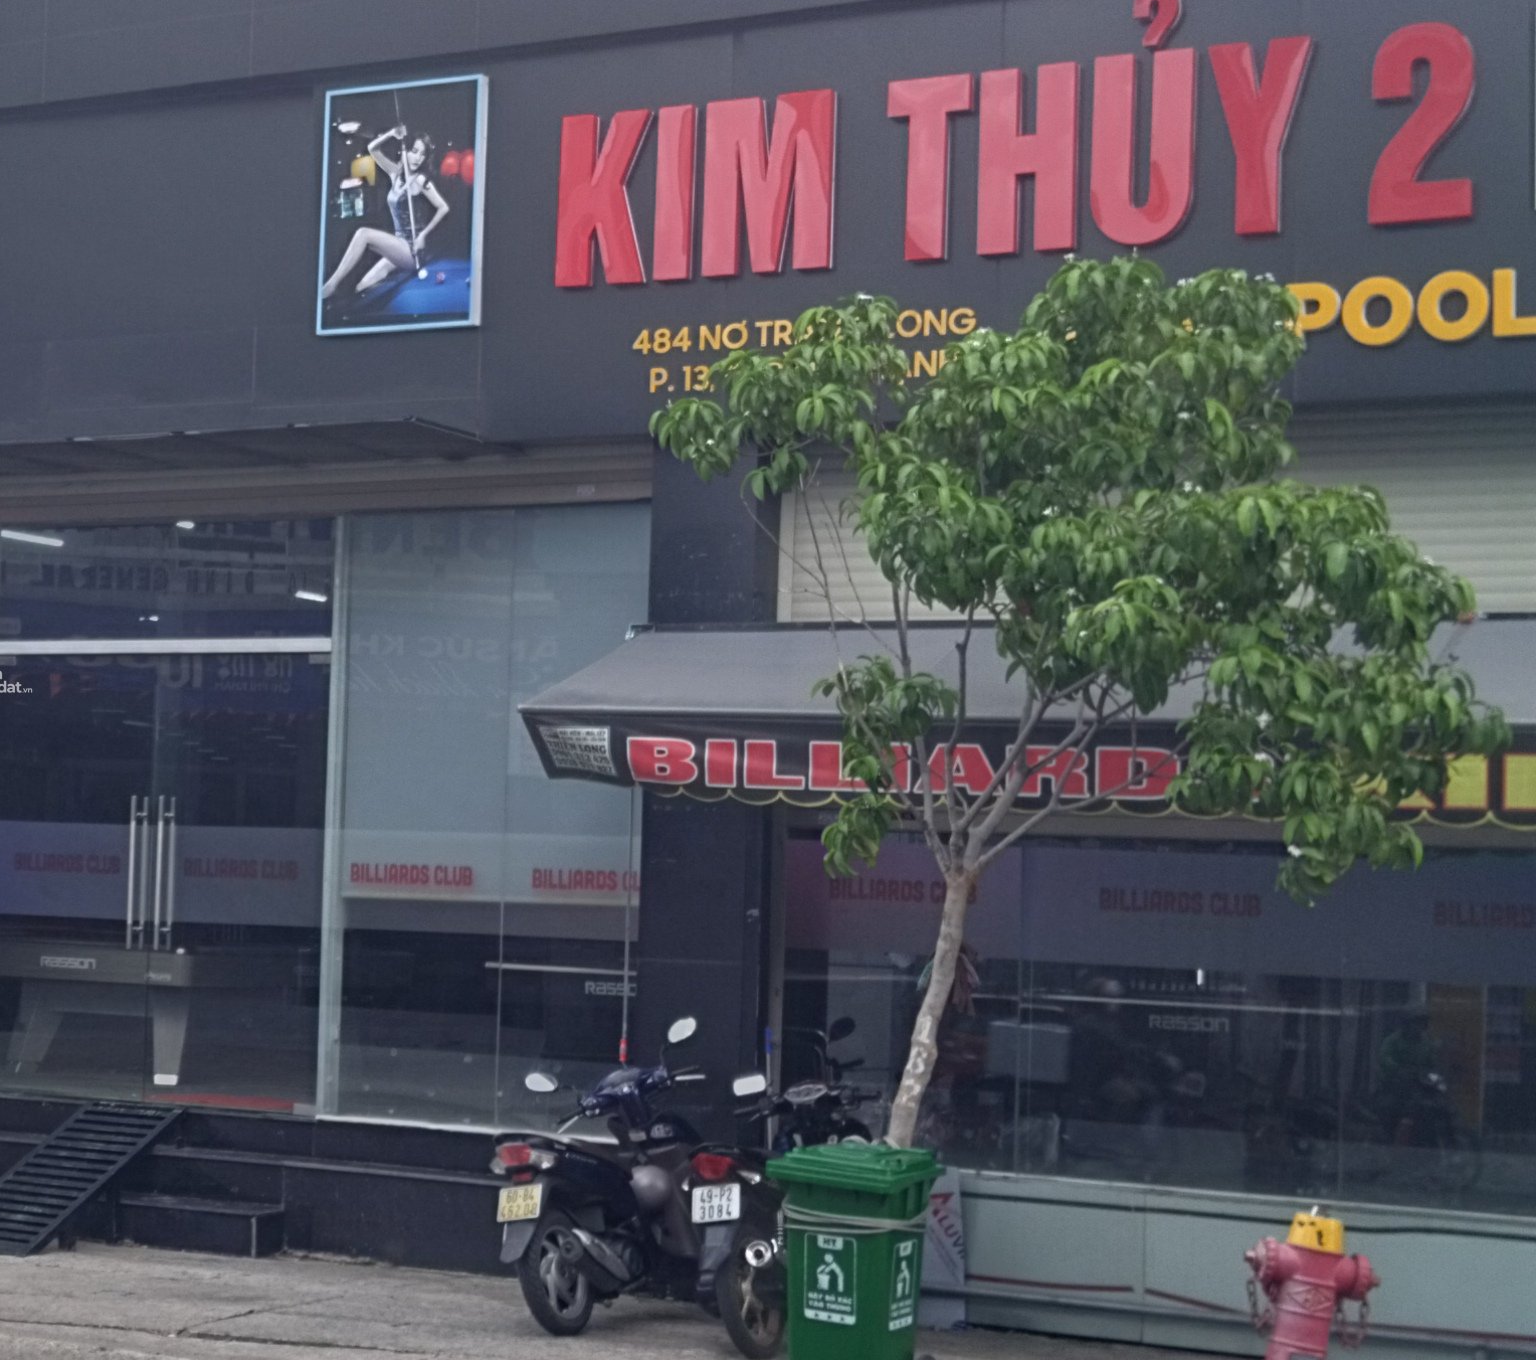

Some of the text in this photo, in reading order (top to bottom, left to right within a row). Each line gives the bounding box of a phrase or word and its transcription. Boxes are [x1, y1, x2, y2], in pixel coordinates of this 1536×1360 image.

[554, 88, 838, 288] KIM
[1367, 21, 1475, 226] 2
[1286, 268, 1536, 347] POOL
[632, 326, 692, 356] 484
[890, 306, 978, 340] ONG
[649, 367, 675, 394] P.
[627, 736, 1186, 801] BILLIARD
[350, 862, 474, 887] BILLIARDS CLUB
[532, 868, 618, 891] BILLIARDS
[830, 878, 924, 904] BILLIARDS
[1099, 887, 1262, 917] BILLIARDS CLUB
[699, 1204, 733, 1220] 3084
